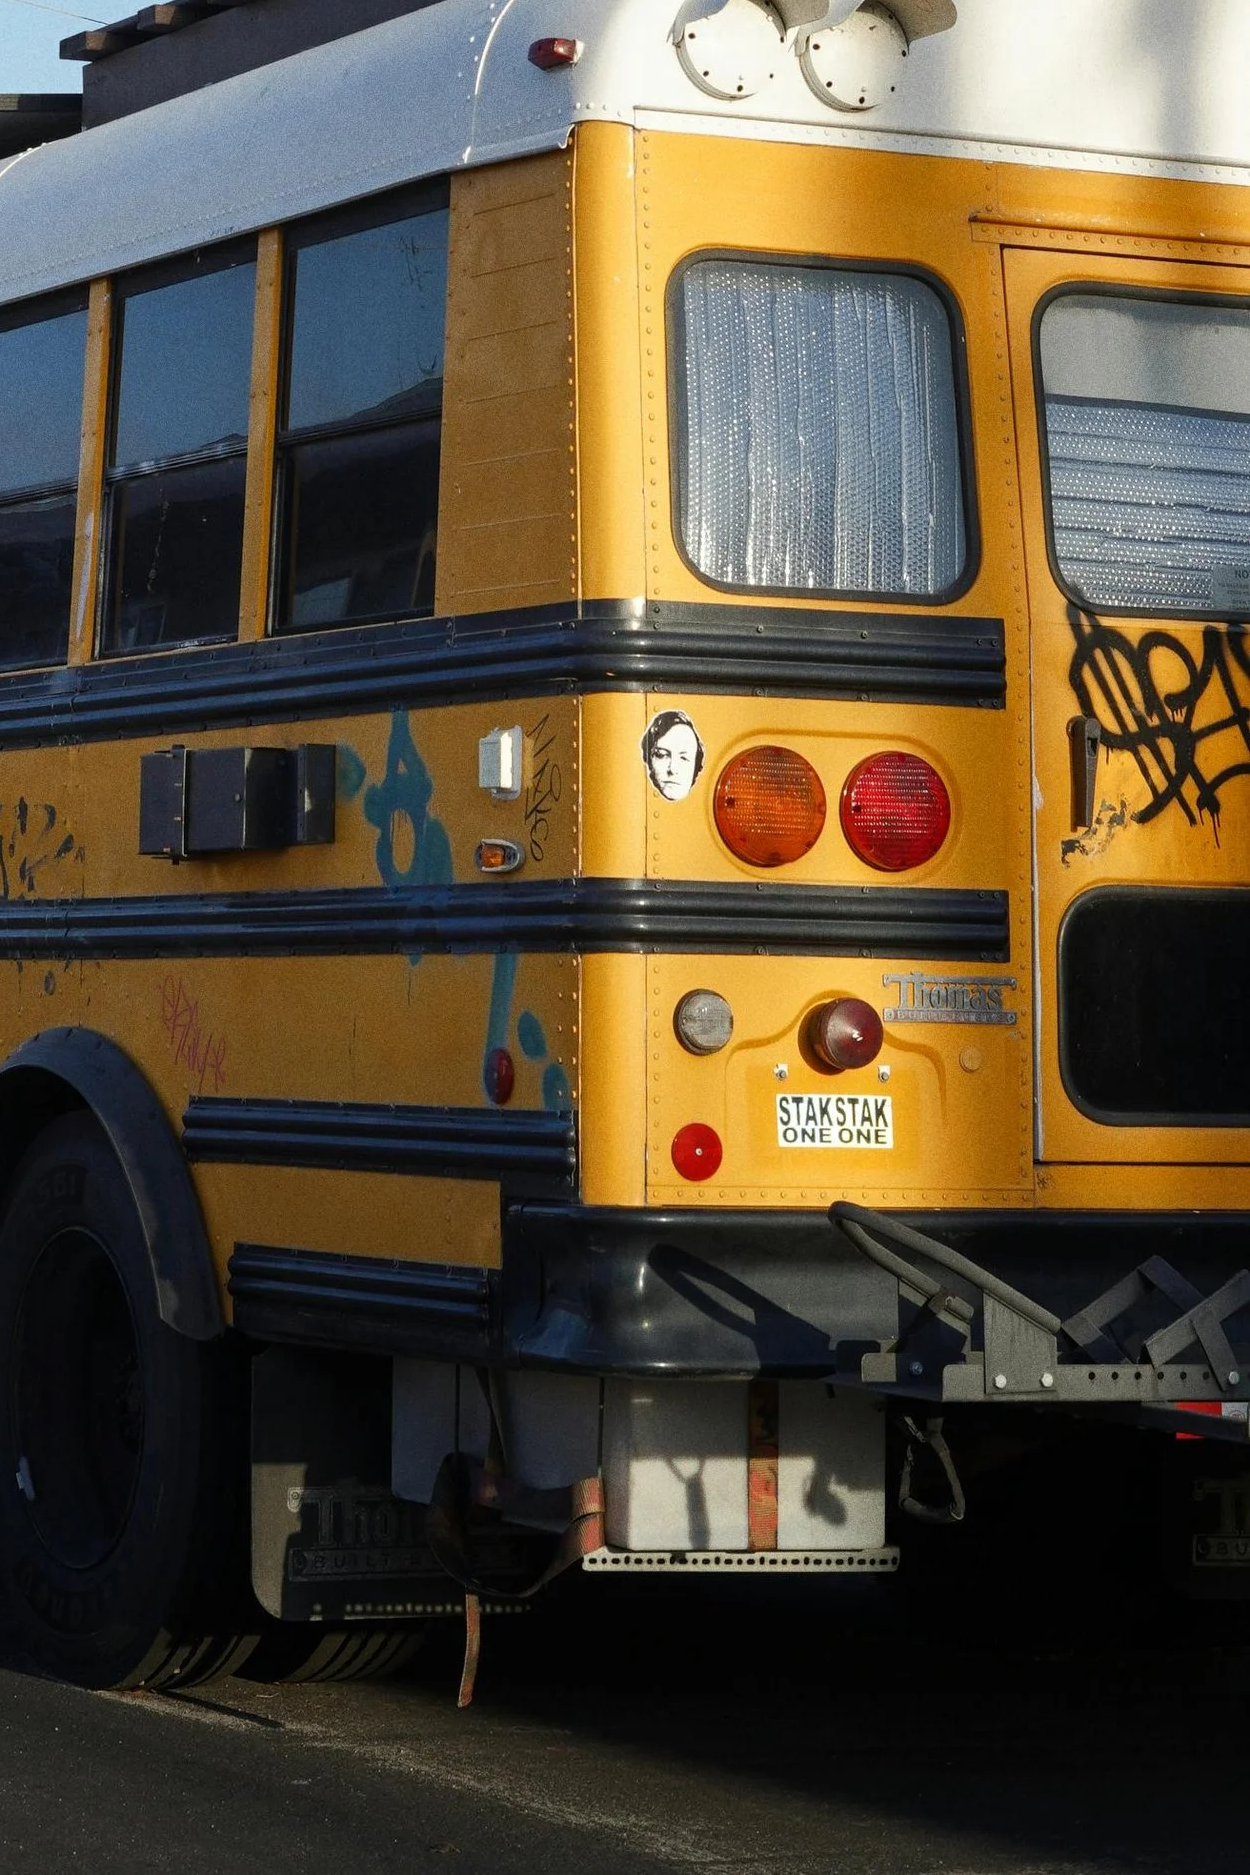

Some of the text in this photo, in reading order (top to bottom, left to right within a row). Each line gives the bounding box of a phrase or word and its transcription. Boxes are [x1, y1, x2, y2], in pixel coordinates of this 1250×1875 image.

[1234, 569, 1250, 579] NO
[884, 970, 1014, 1010] Thomas
[782, 1127, 887, 1144] ONE ONE
